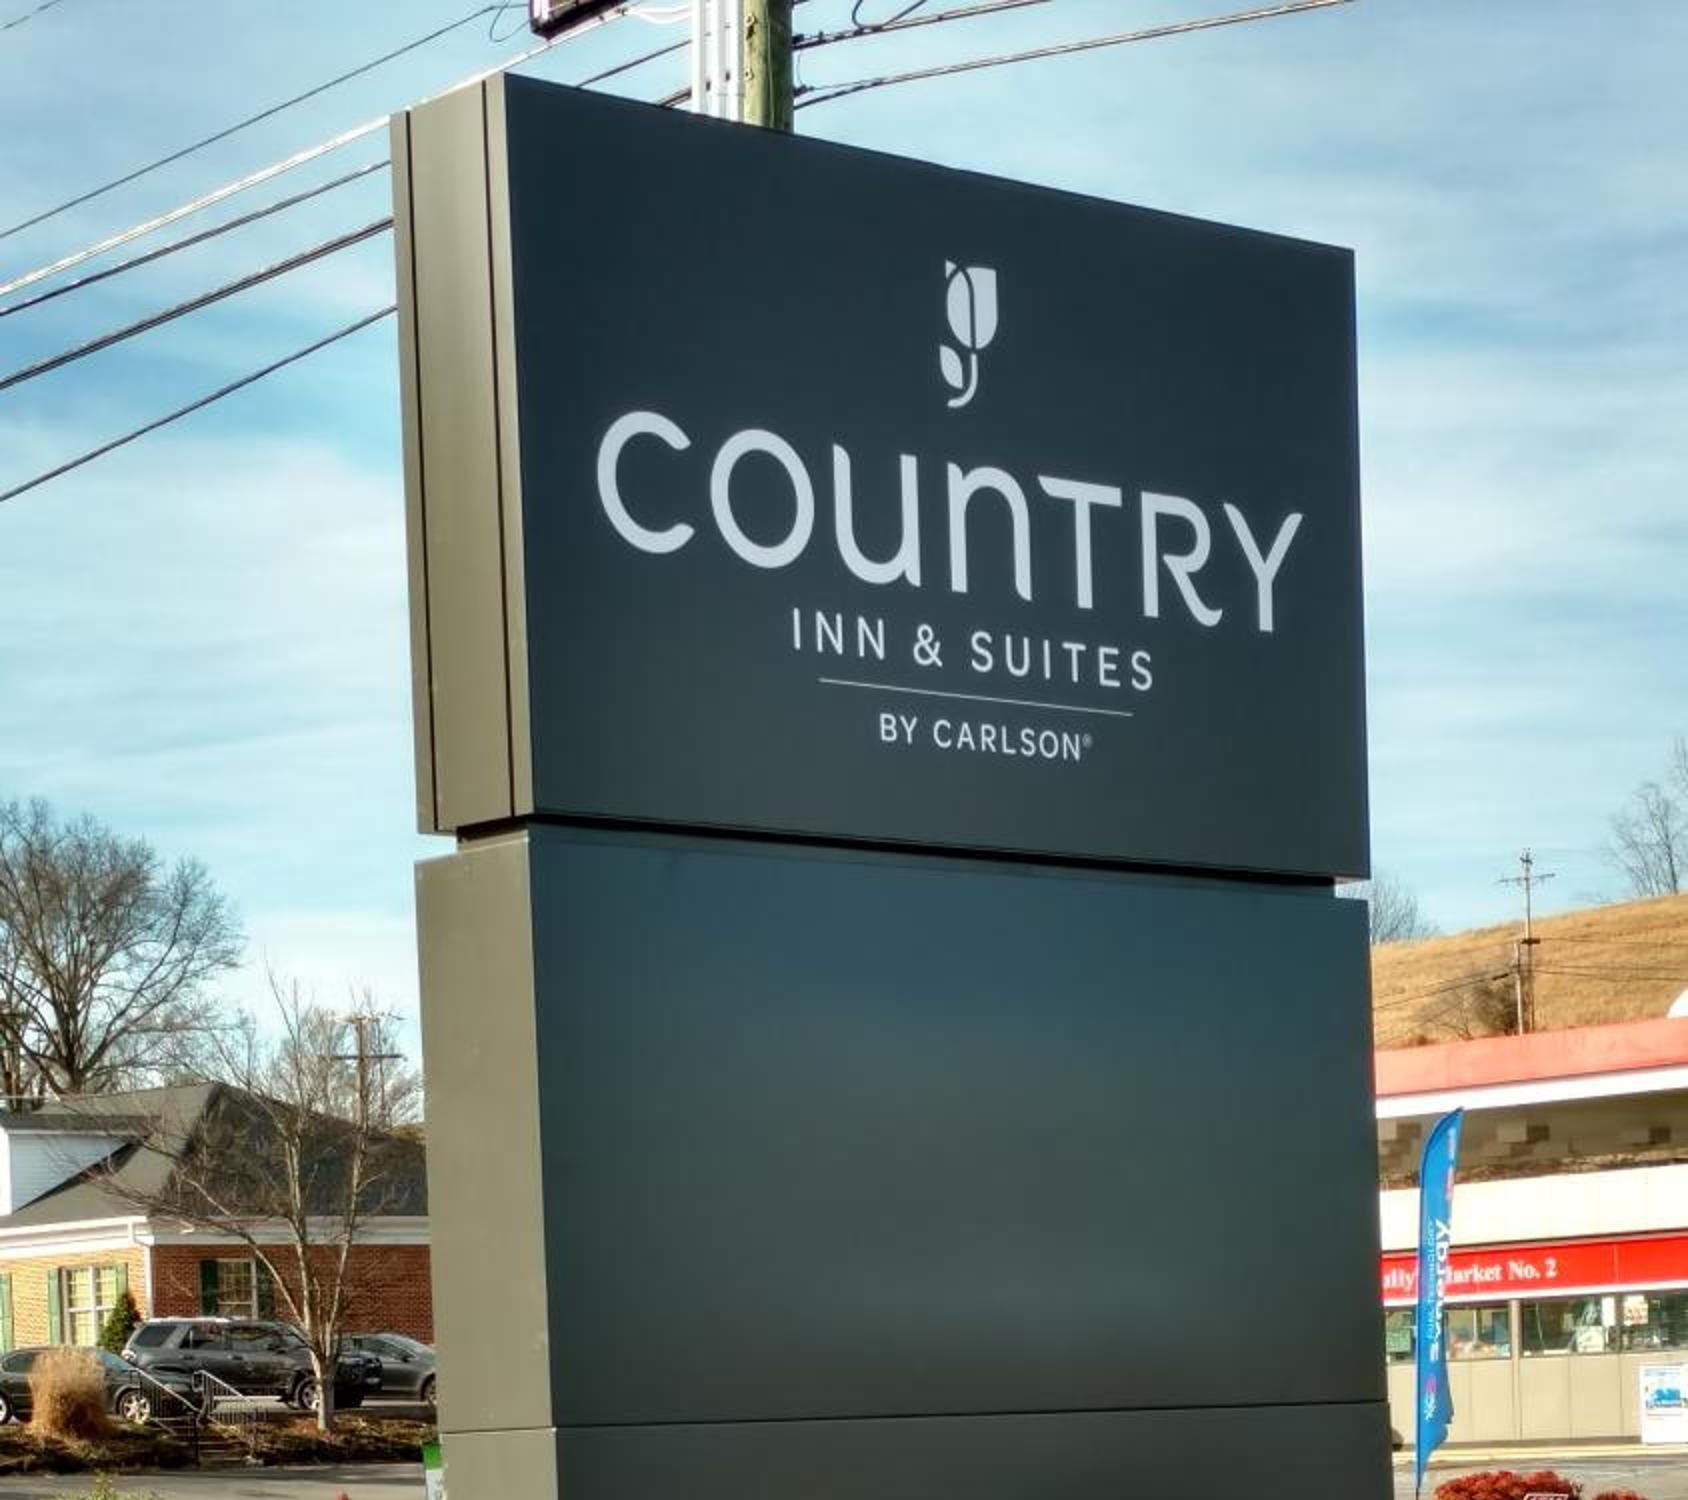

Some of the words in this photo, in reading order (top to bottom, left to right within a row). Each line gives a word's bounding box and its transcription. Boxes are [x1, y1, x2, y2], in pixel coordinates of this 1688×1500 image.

[793, 608, 884, 660] INN
[913, 624, 943, 667] &
[971, 631, 1152, 691] SUITES
[880, 713, 917, 744] BY
[1508, 1261, 1541, 1280] No.
[1545, 1258, 1558, 1278] 2
